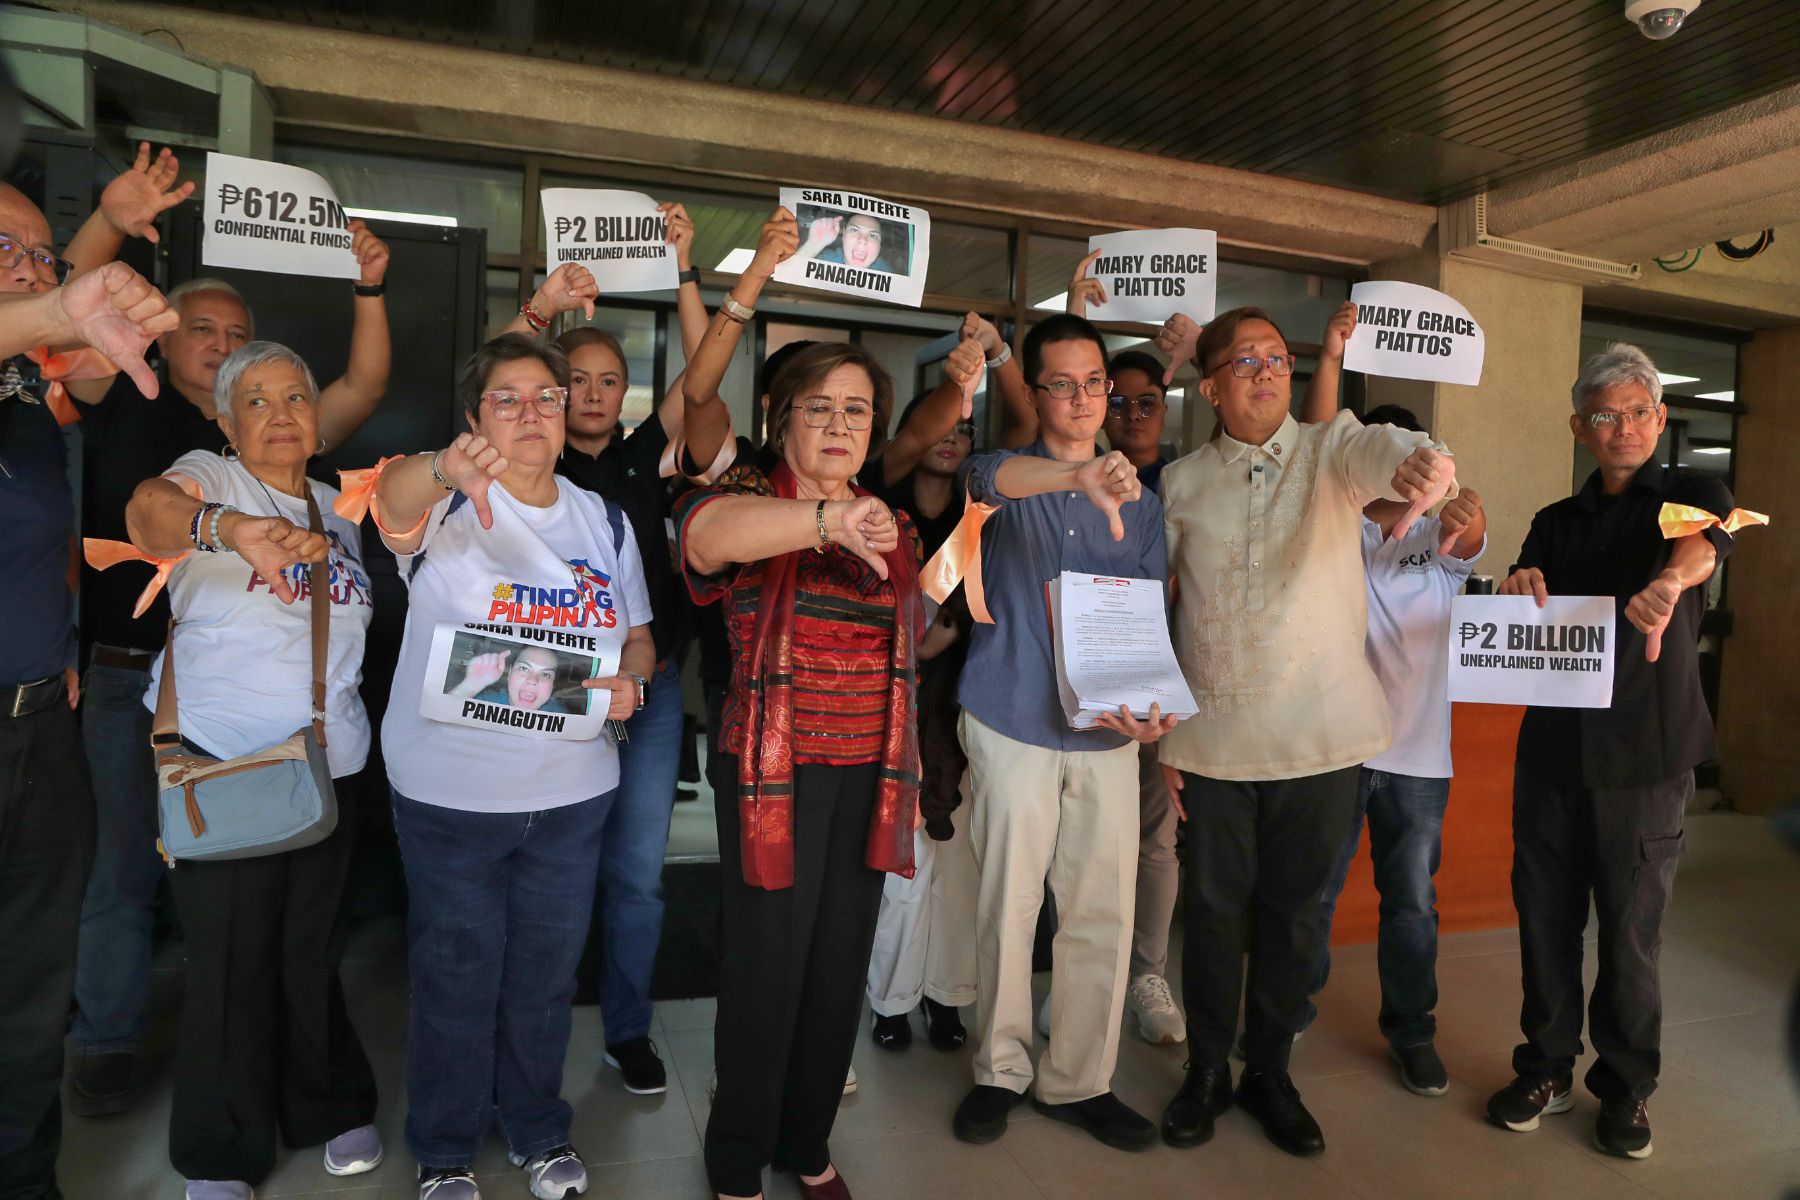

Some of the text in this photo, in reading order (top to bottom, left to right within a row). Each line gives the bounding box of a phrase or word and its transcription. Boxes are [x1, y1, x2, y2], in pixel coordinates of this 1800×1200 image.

[802, 191, 910, 219] SARA DUTERTE
[214, 219, 351, 250] CONFIDENTIAL FUNDS
[554, 216, 667, 242] ₱2 BILLION
[558, 246, 667, 261] UNEXPLAINED WEALTH
[1095, 254, 1208, 275] MARY GRACE
[805, 261, 892, 293] PANAGUTIN
[1114, 277, 1186, 297] PIATTOS
[1357, 304, 1476, 337] MARY GRACE
[1375, 330, 1453, 357] PIATTOS
[520, 626, 596, 651] DUTERTE
[1459, 622, 1605, 653] ₱2 BILLION
[1460, 653, 1602, 672] UNEXPLAINED WEALTH
[462, 700, 566, 733] PANAGUTIN
